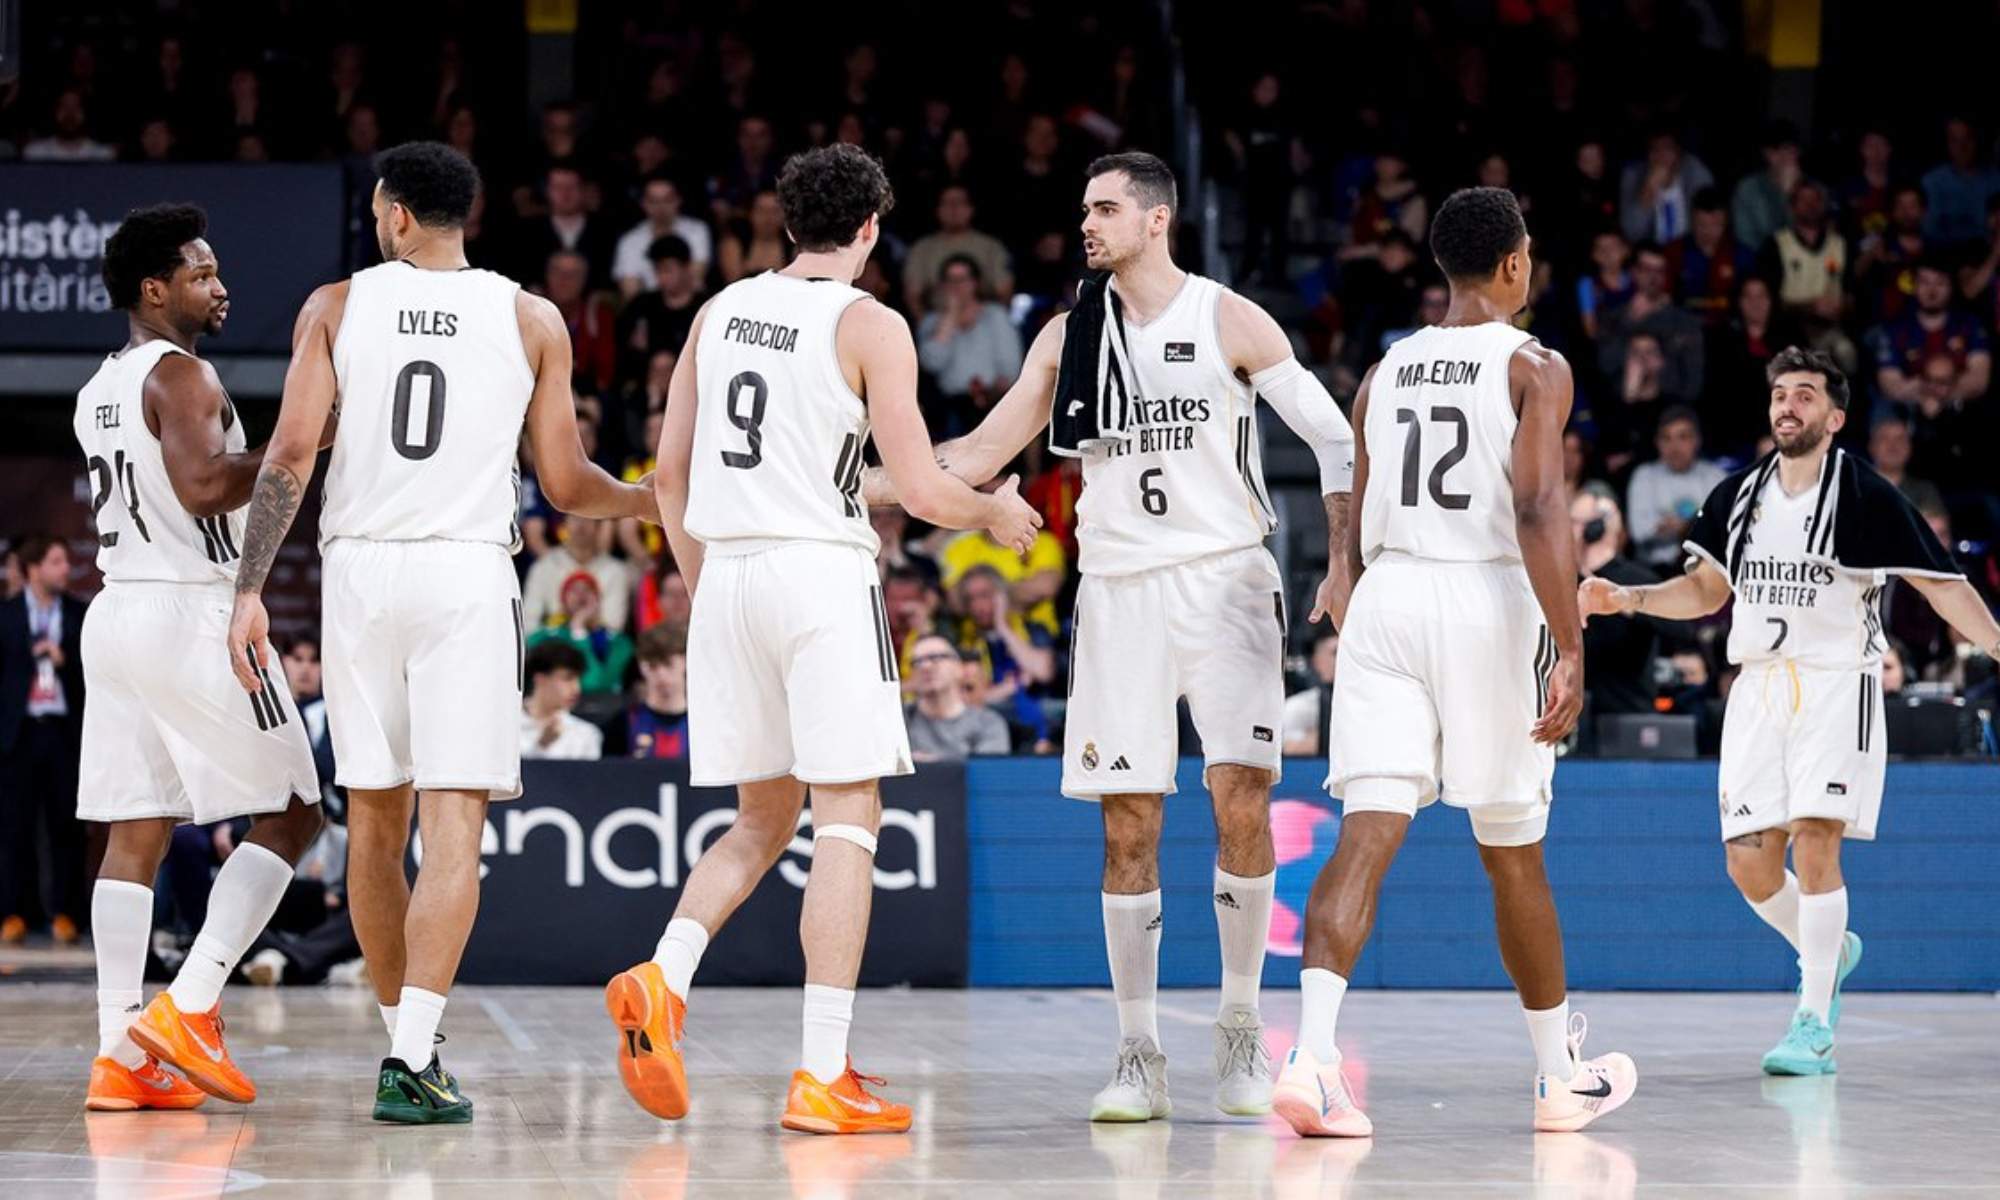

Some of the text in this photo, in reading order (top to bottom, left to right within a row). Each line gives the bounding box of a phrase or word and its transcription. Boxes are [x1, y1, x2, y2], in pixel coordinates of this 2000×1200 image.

[0, 209, 122, 259] istè
[398, 310, 459, 337] LYLES
[723, 316, 799, 353] PROCIDA
[1396, 360, 1482, 388] MAEDON
[391, 360, 446, 460] 0
[721, 371, 769, 469] 9
[1129, 395, 1210, 425] irates
[1140, 426, 1194, 453] BETTER
[1396, 405, 1472, 510] 12
[89, 450, 151, 548] 24
[1139, 467, 1168, 516] 6
[1741, 556, 1835, 585] mirates
[1769, 585, 1817, 608] BETTER
[1766, 617, 1788, 651] 7
